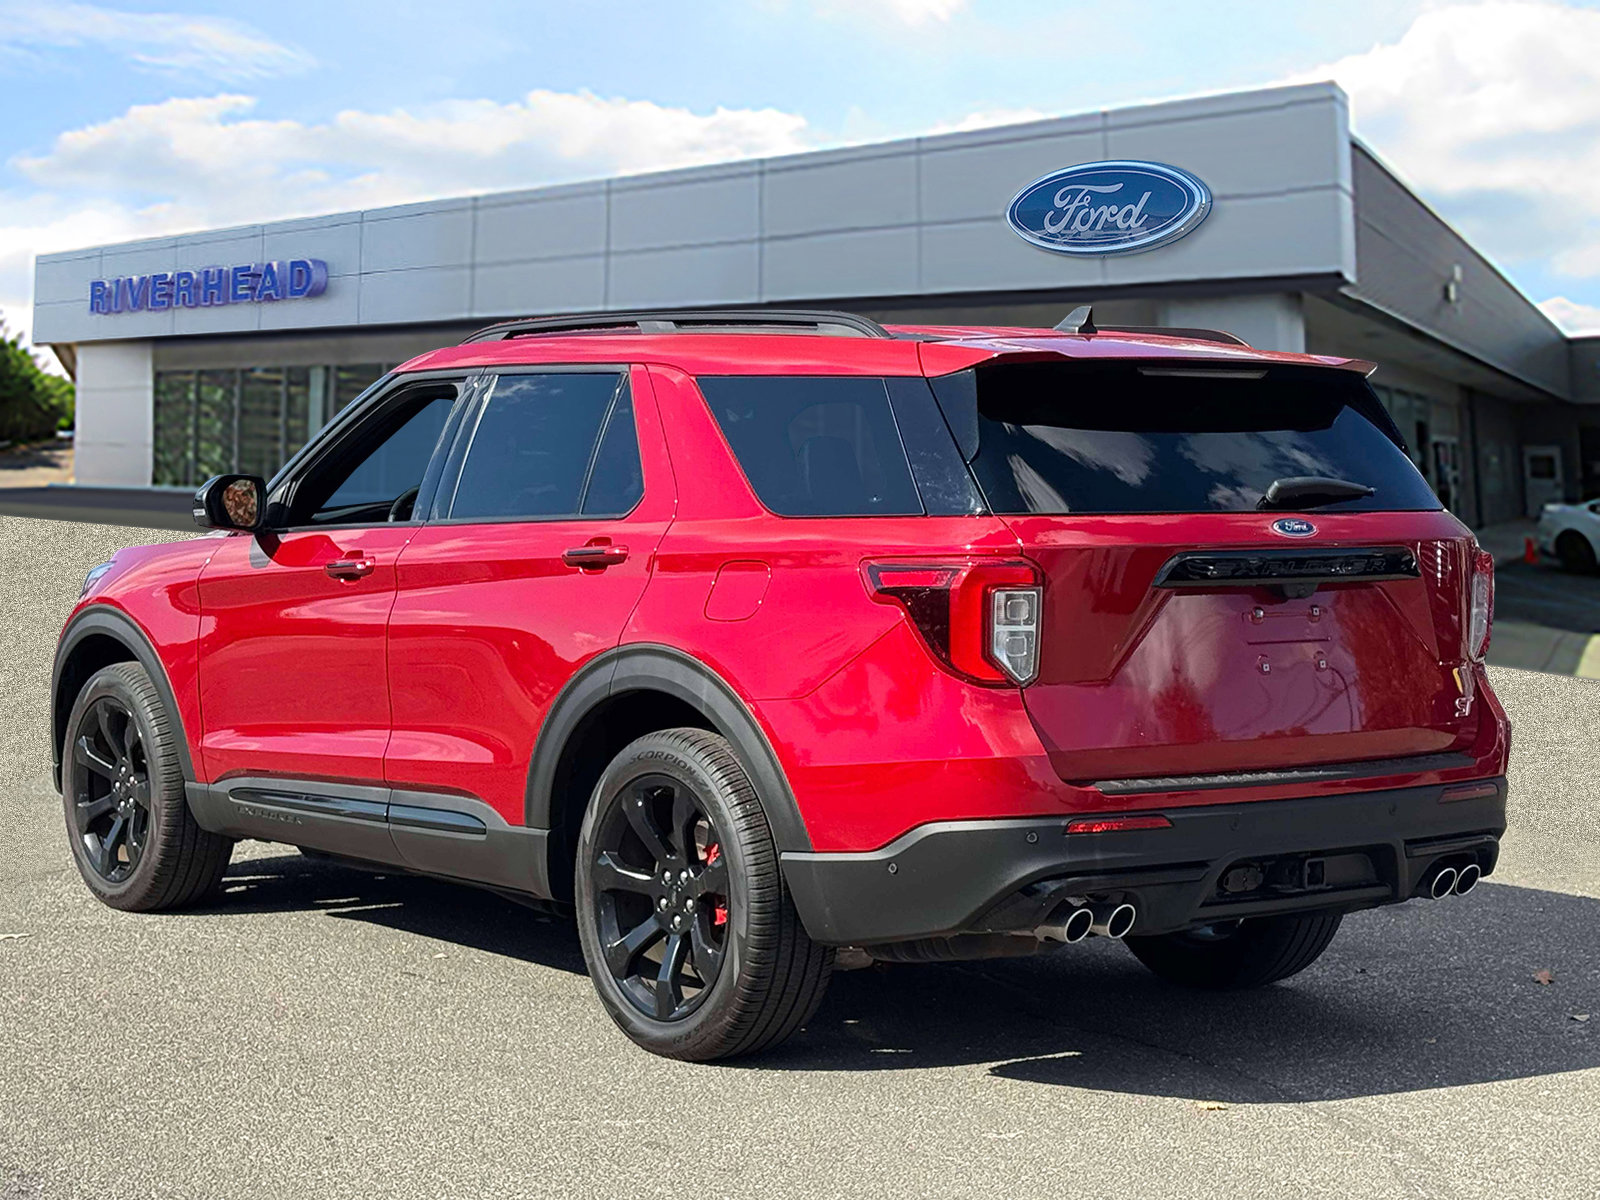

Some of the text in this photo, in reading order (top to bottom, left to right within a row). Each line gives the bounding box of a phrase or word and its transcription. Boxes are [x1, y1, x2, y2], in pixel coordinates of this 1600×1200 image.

[1044, 182, 1152, 234] Ford
[89, 259, 324, 315] RIVERHEAD
[1285, 521, 1309, 531] Ford
[628, 749, 697, 776] SCORPION
